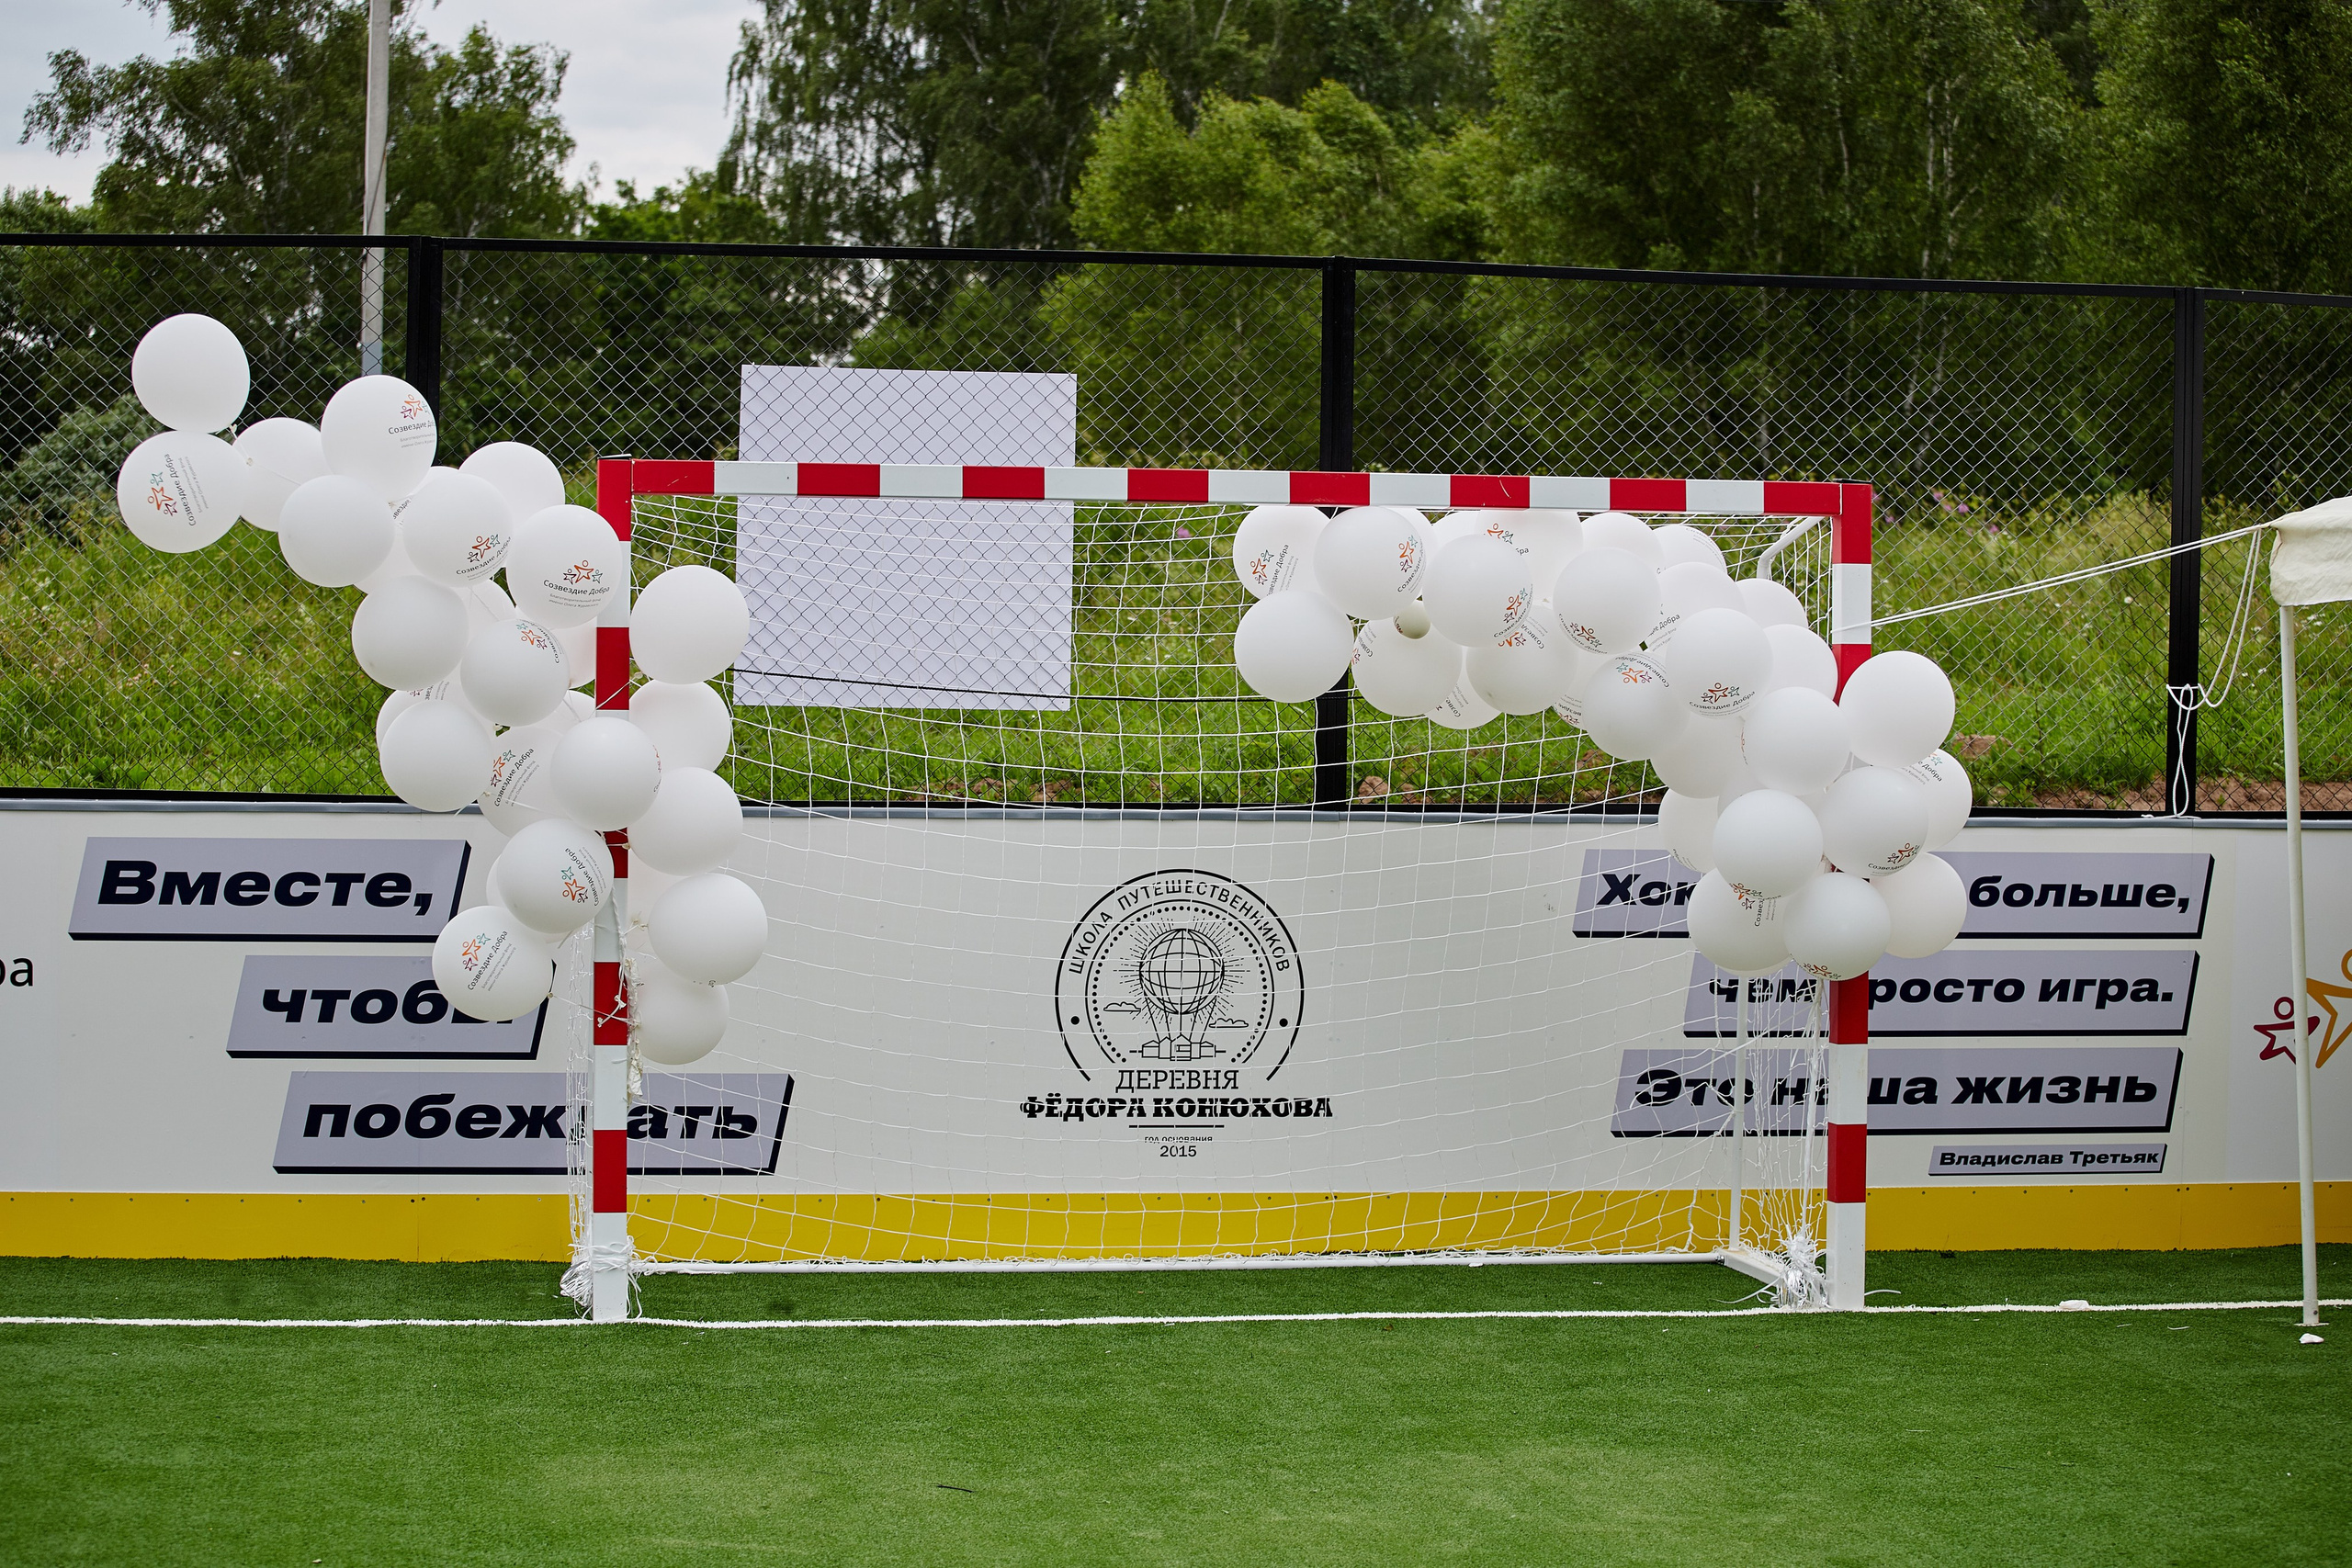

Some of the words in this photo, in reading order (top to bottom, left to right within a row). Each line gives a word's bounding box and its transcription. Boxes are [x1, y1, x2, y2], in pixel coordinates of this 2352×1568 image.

[388, 423, 426, 434] Созвездие
[164, 454, 179, 479] Добра
[175, 479, 197, 526] Созвездие
[456, 556, 495, 575] Созвездие
[1275, 544, 1289, 570] Добра
[543, 579, 588, 595] Созвездие
[588, 586, 610, 595] Добра
[1659, 614, 1680, 630] Добра
[1521, 625, 1545, 649] Созвезд
[1689, 701, 1731, 711] Созвездие
[1733, 691, 1756, 707] Добра
[494, 769, 516, 807] Созвездие
[514, 748, 535, 771] Добра
[1922, 763, 1942, 783] Добра
[564, 847, 586, 870] Добра
[97, 859, 435, 917] Вместе,
[582, 870, 600, 907] Созвездие
[1968, 874, 2191, 914] больше,
[1068, 910, 1114, 975] ШКОЛА
[1116, 879, 1292, 972] ПУТЕШЕСТВЕННИКОВ
[467, 953, 494, 991] Созвездие
[491, 931, 508, 953] Добра
[262, 978, 514, 1024] чтоб
[1867, 977, 2026, 1010] росто
[2037, 977, 2174, 1010] игра.
[1114, 1069, 1240, 1094] ДЕРЕВНЯ
[1634, 1068, 1756, 1107] Это
[1950, 1075, 2159, 1105] жизнь
[302, 1092, 759, 1145] побежать
[1019, 1092, 1148, 1122] ФЁДОРА
[1152, 1097, 1334, 1119] КОНЮХОВА
[1159, 1145, 1197, 1157] 2015
[1939, 1151, 2064, 1168] Владислав
[2069, 1150, 2160, 1168] Третьяк
